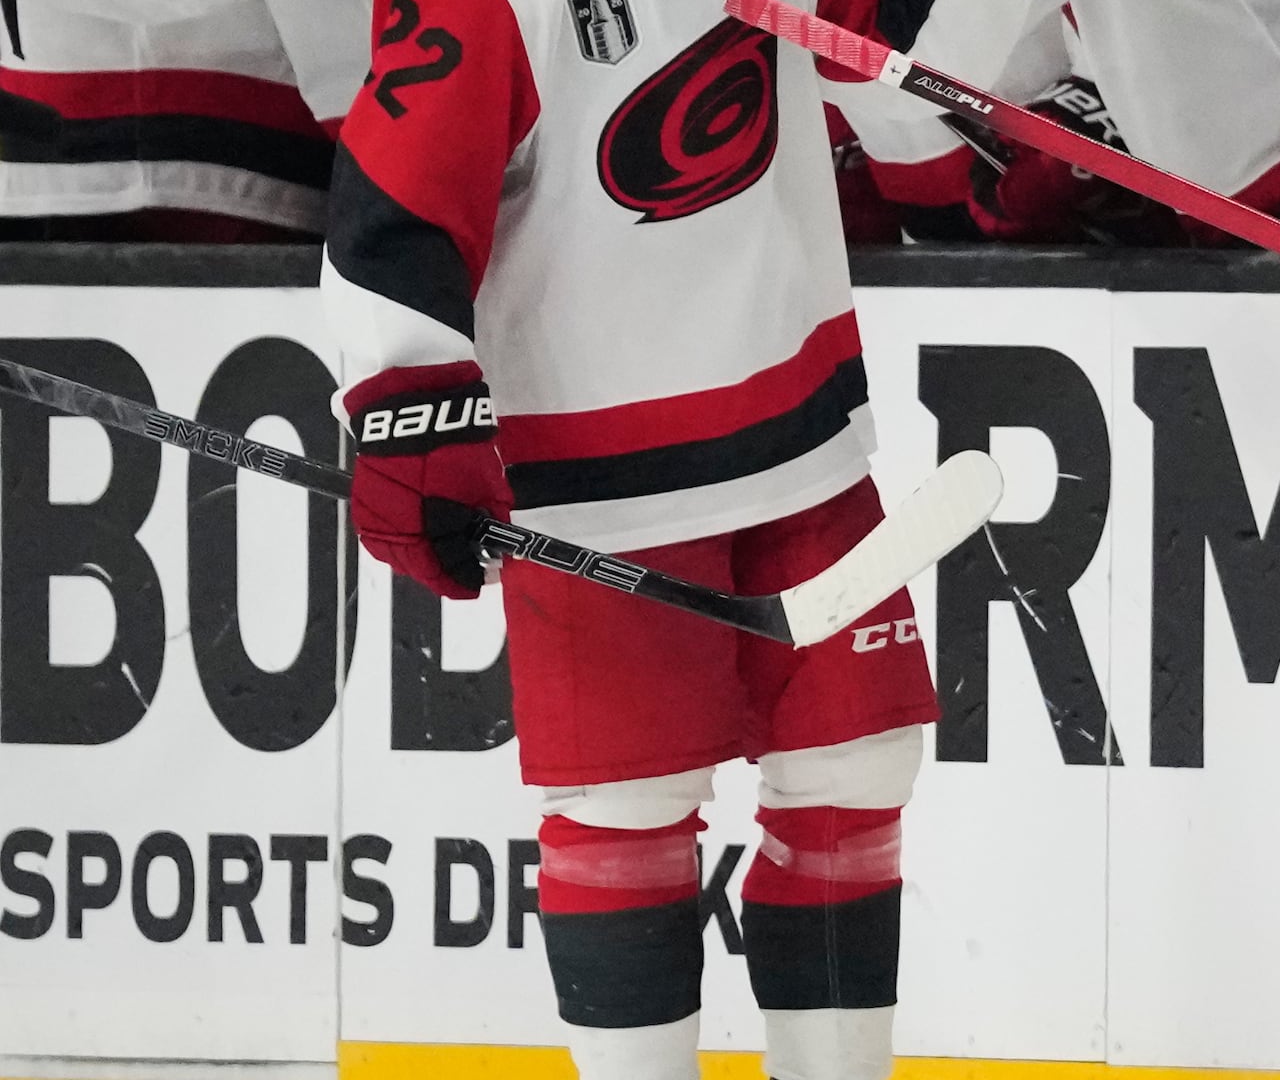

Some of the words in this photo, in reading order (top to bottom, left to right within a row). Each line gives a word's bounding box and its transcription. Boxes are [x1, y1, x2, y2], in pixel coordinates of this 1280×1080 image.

[142, 412, 290, 478] SMOKE
[361, 394, 498, 443] BAUE
[476, 517, 649, 595] RUE
[850, 616, 919, 654] CC
[0, 827, 395, 949] SPORTS
